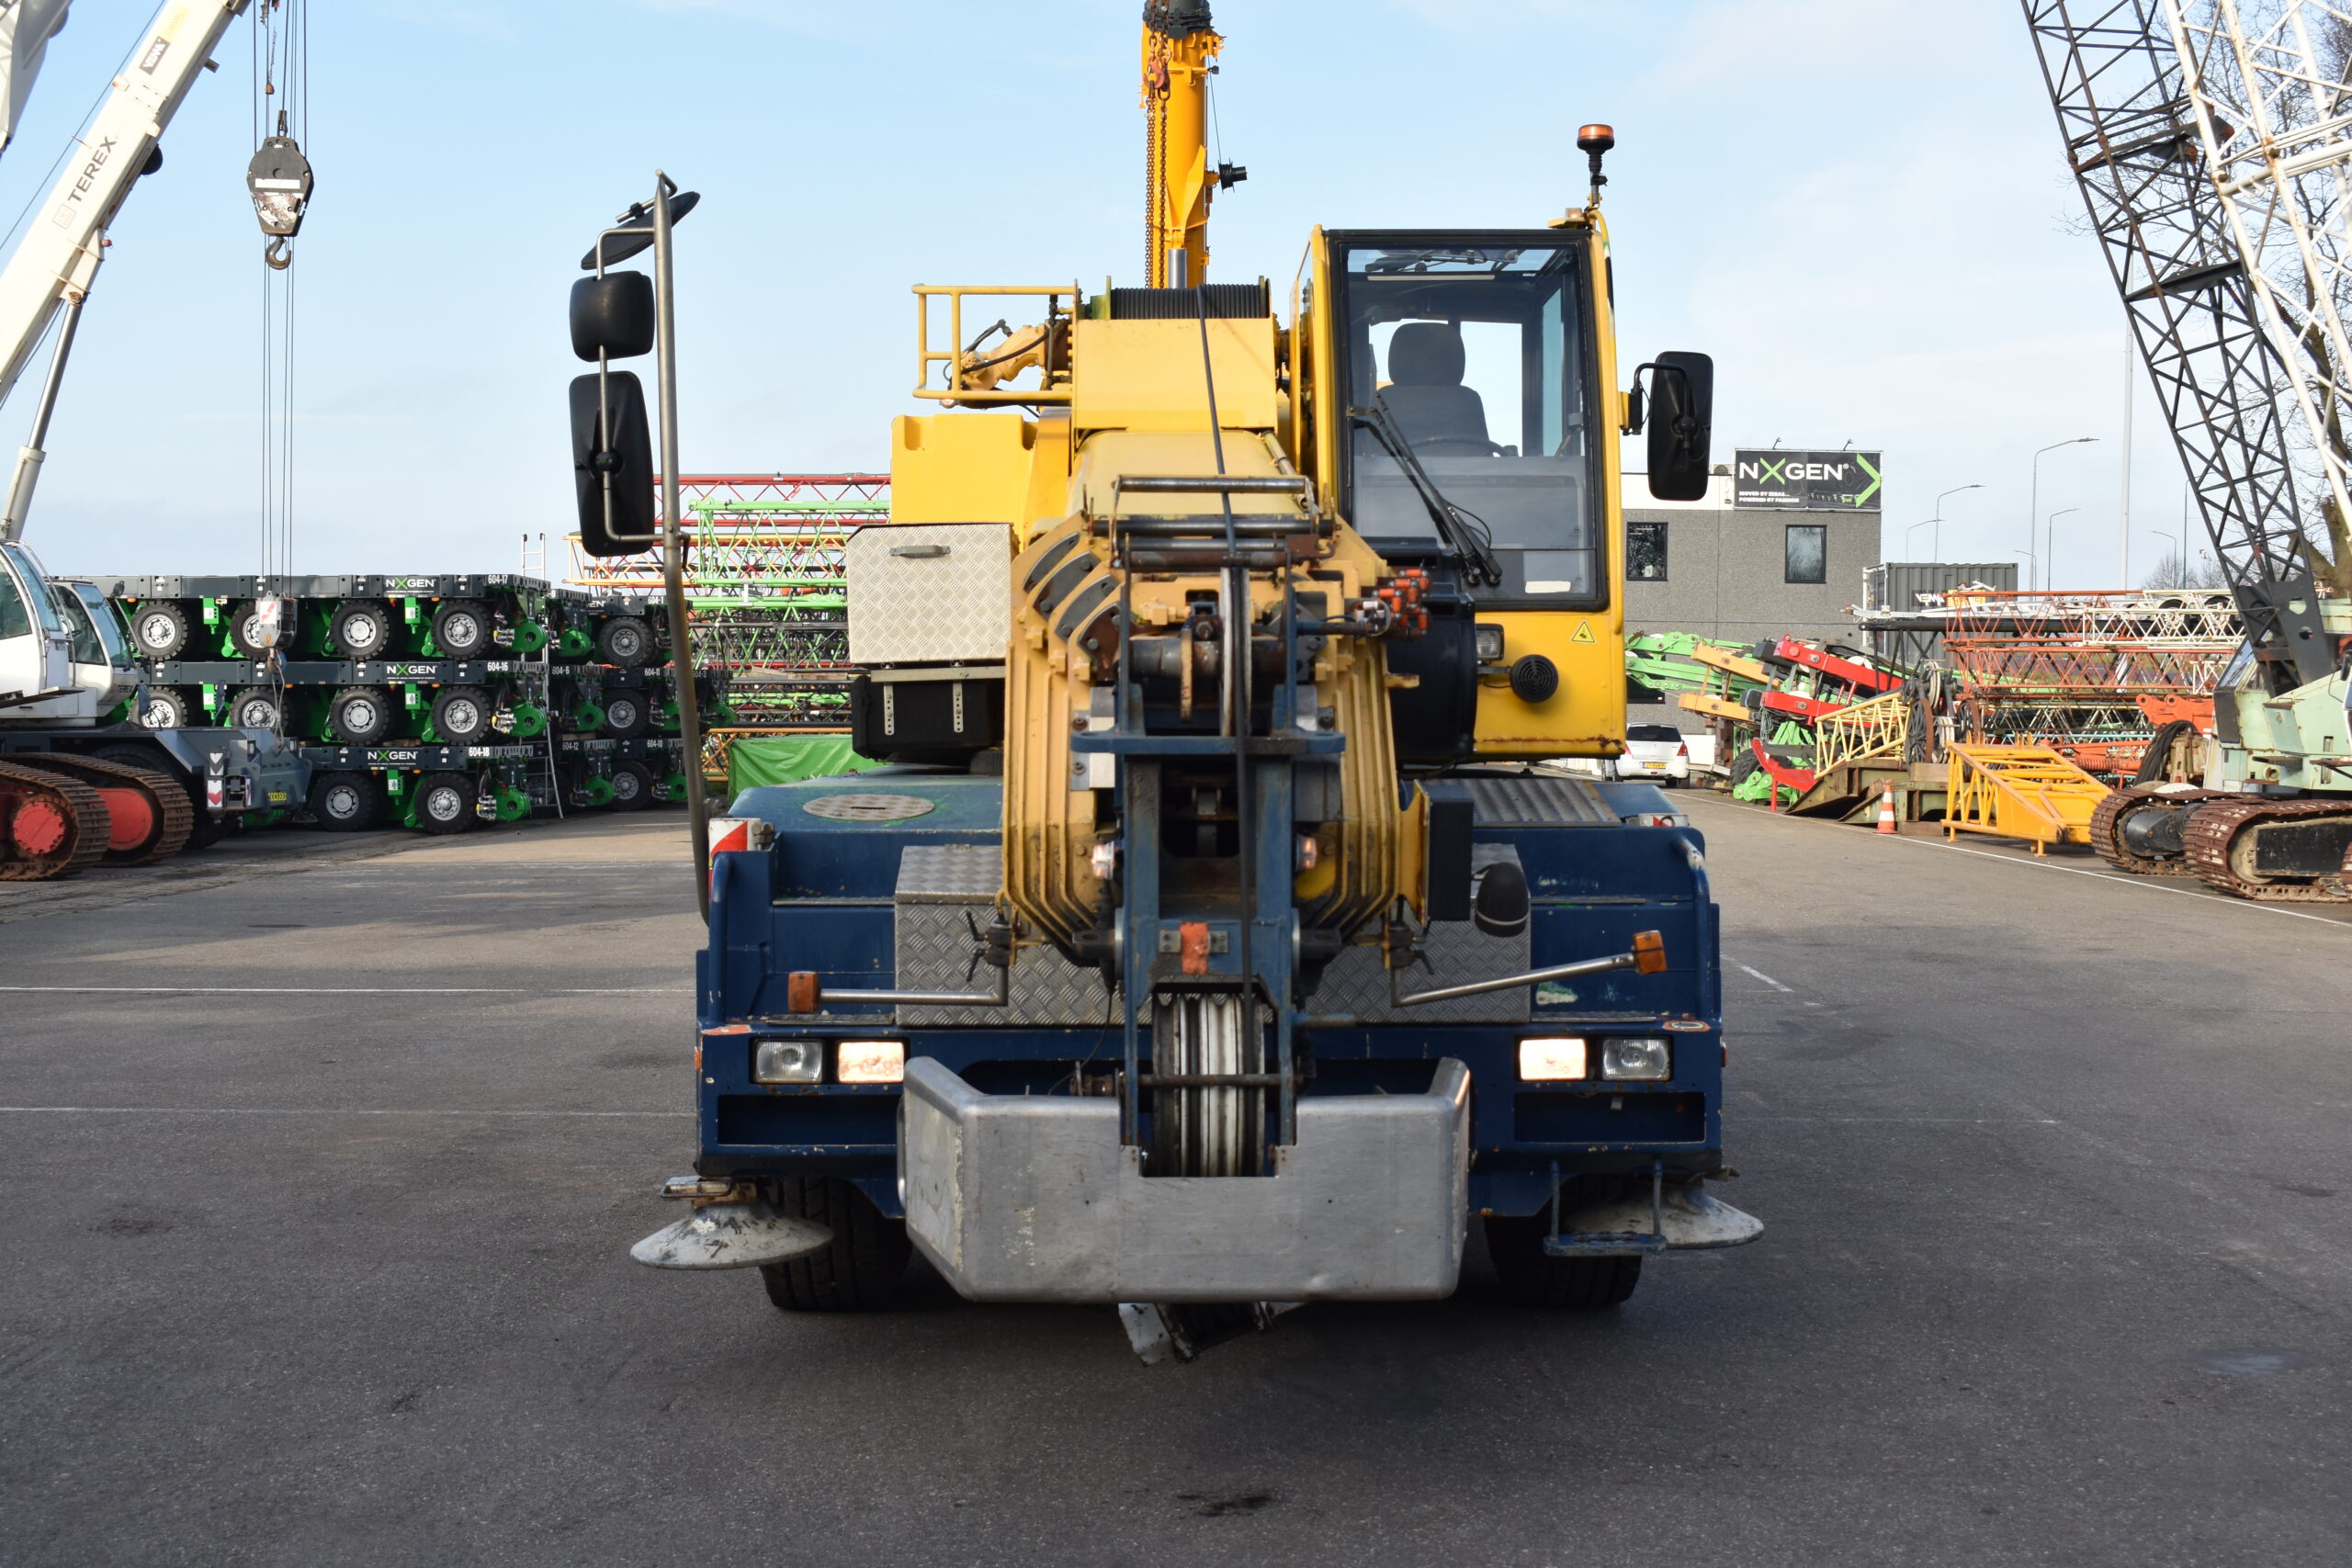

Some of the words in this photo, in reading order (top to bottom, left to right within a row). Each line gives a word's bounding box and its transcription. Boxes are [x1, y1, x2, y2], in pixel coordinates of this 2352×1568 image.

[67, 135, 118, 202] TEREX
[488, 574, 508, 584] 604-17
[487, 661, 508, 671] 604-16
[469, 747, 490, 757] 604-18
